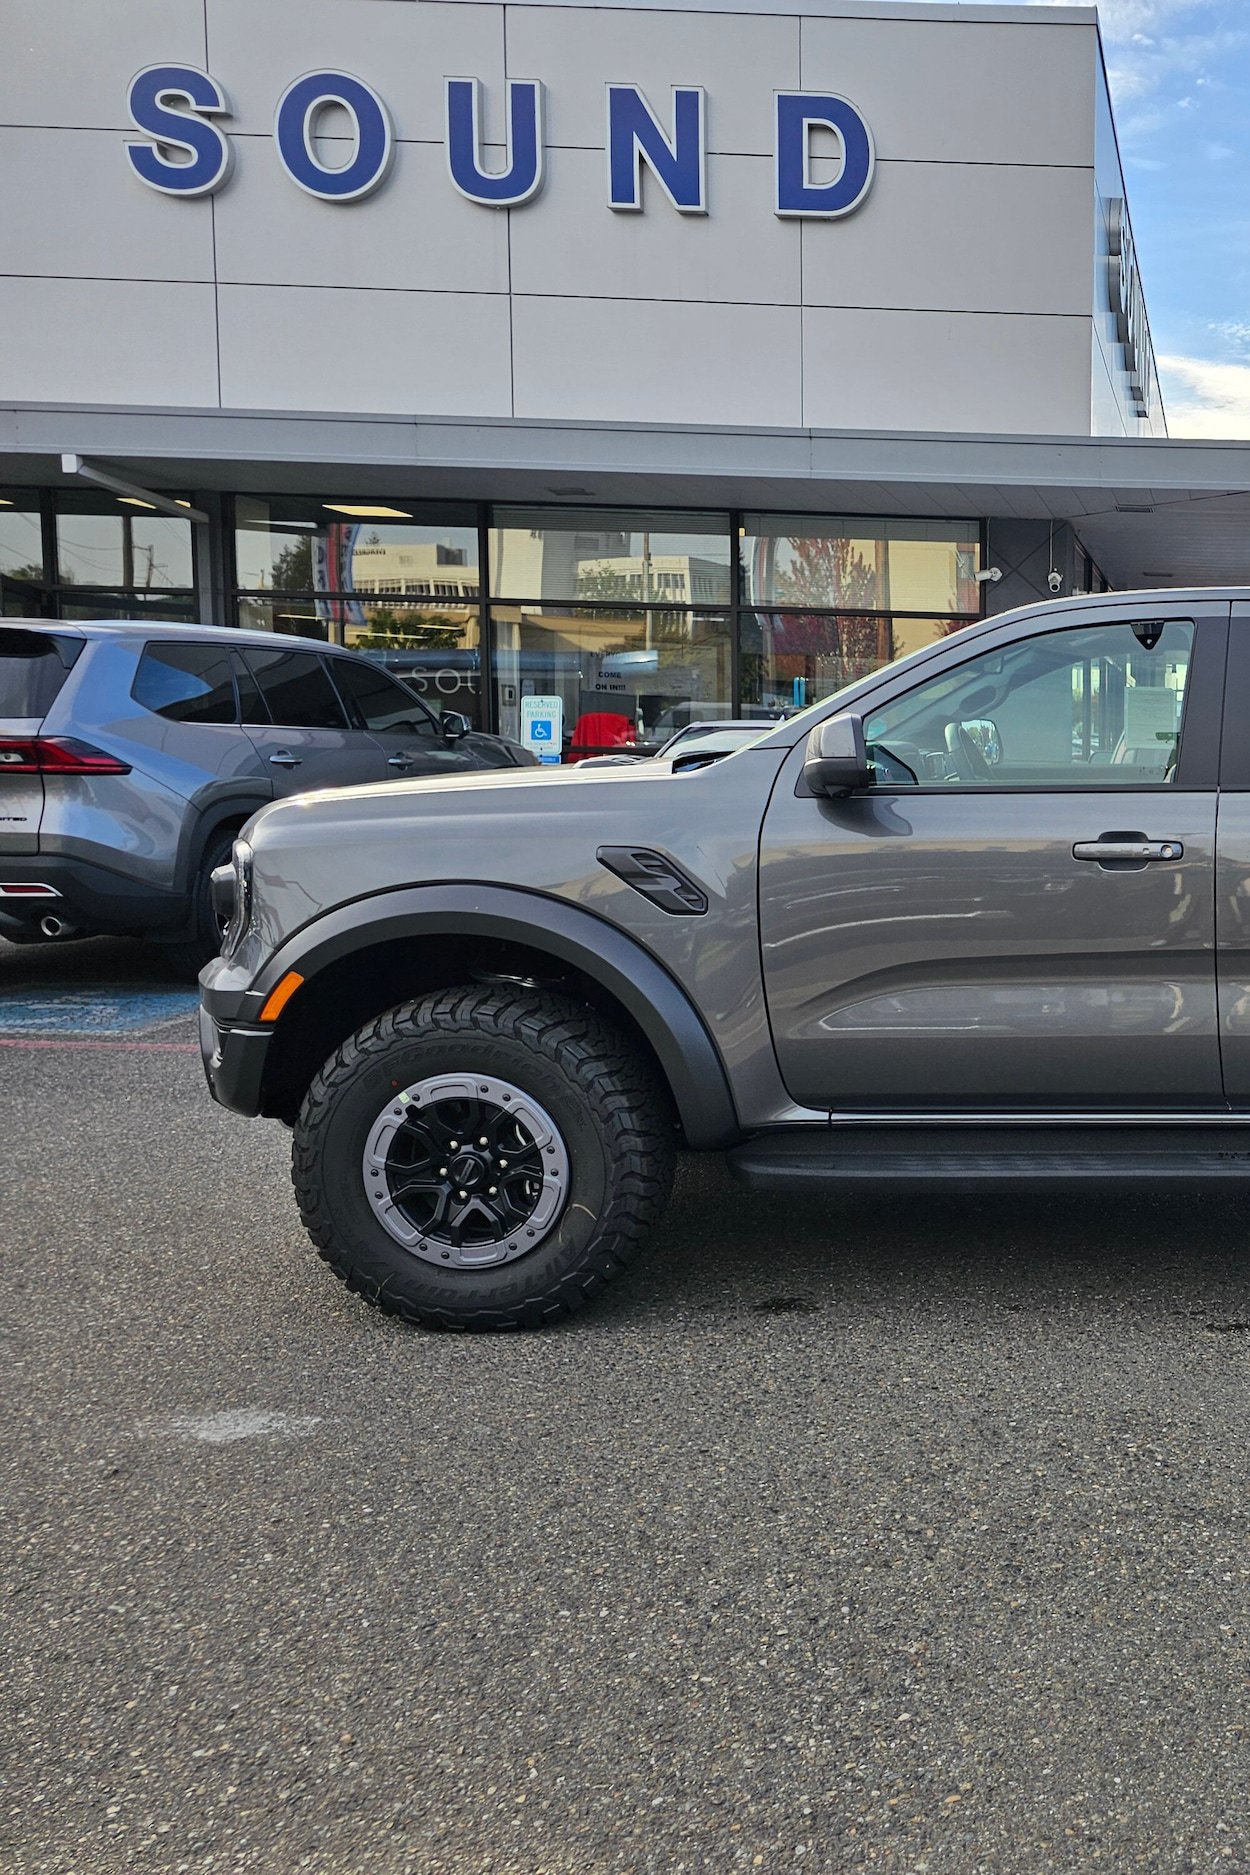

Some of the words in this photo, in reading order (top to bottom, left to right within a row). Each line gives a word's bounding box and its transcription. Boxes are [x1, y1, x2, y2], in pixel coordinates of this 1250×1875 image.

[125, 62, 876, 219] SOUND
[598, 671, 622, 679] COME
[595, 683, 608, 691] ON
[525, 700, 559, 710] RESERVED
[526, 710, 557, 719] PARKING
